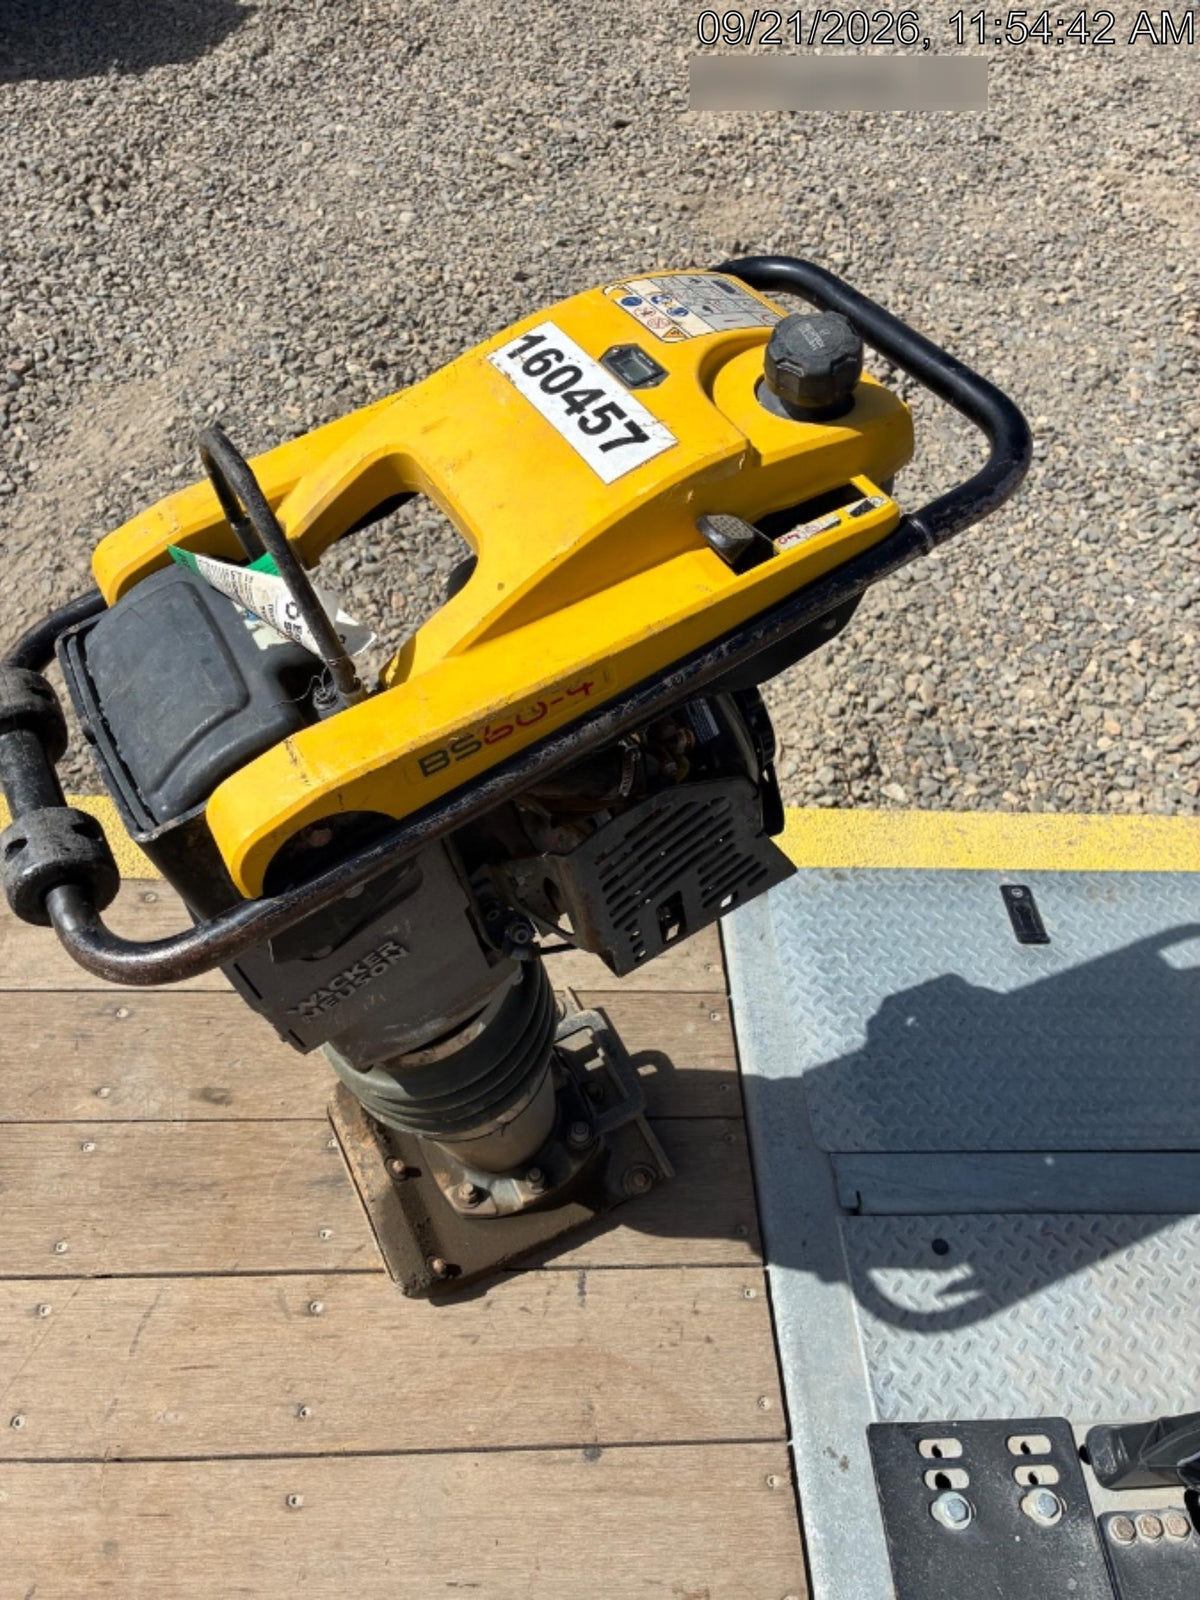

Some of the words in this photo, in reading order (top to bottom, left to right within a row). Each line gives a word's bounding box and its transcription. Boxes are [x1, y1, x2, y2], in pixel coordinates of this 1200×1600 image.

[506, 334, 651, 453] 160457
[287, 941, 401, 1016] WACKER
[302, 946, 411, 1022] NEUSON
